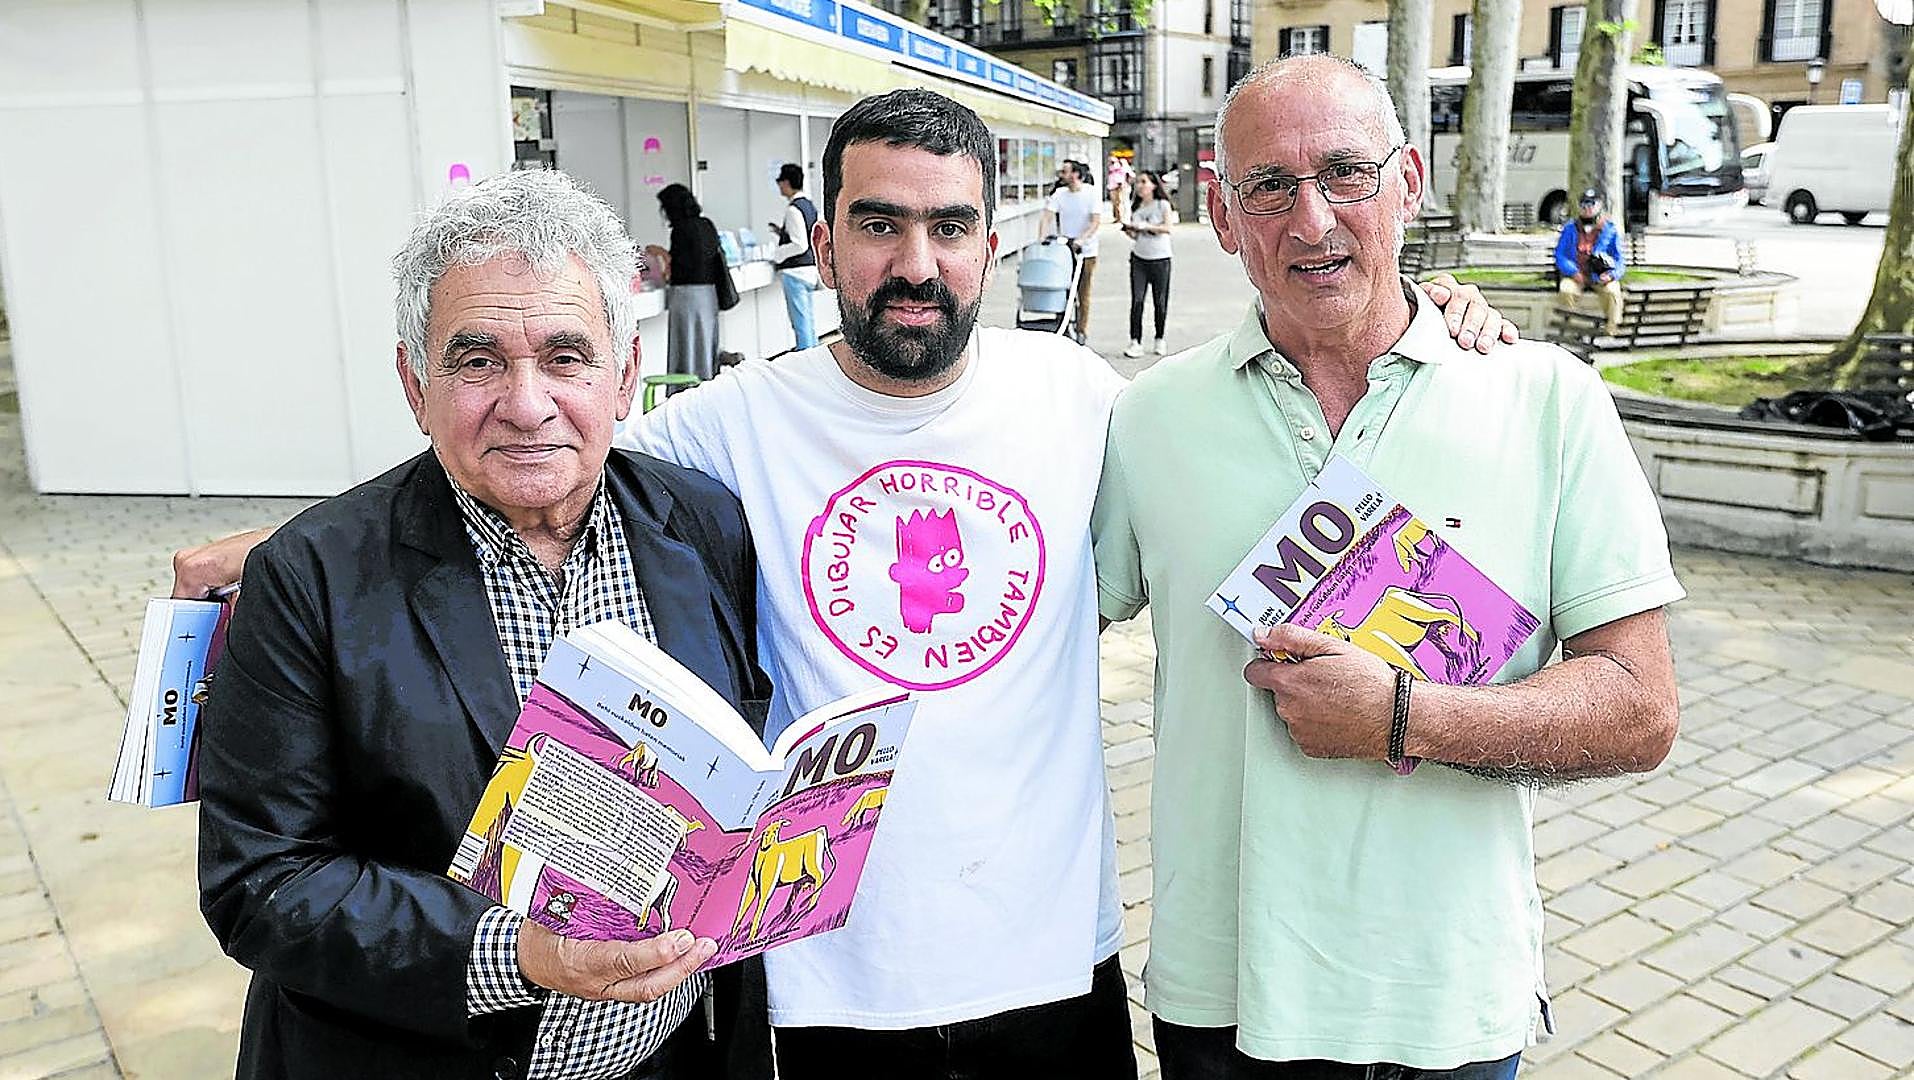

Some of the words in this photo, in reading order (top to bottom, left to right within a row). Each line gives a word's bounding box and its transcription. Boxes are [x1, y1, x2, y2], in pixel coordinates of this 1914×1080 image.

[880, 473, 1029, 544] HORRIBLE
[828, 496, 877, 617] DIBUJAR
[1252, 501, 1355, 609] MO
[859, 625, 899, 660] ES
[924, 570, 1030, 669] TAMBIEN
[163, 689, 178, 726] MO
[628, 693, 668, 728] MO
[783, 722, 877, 796] MO
